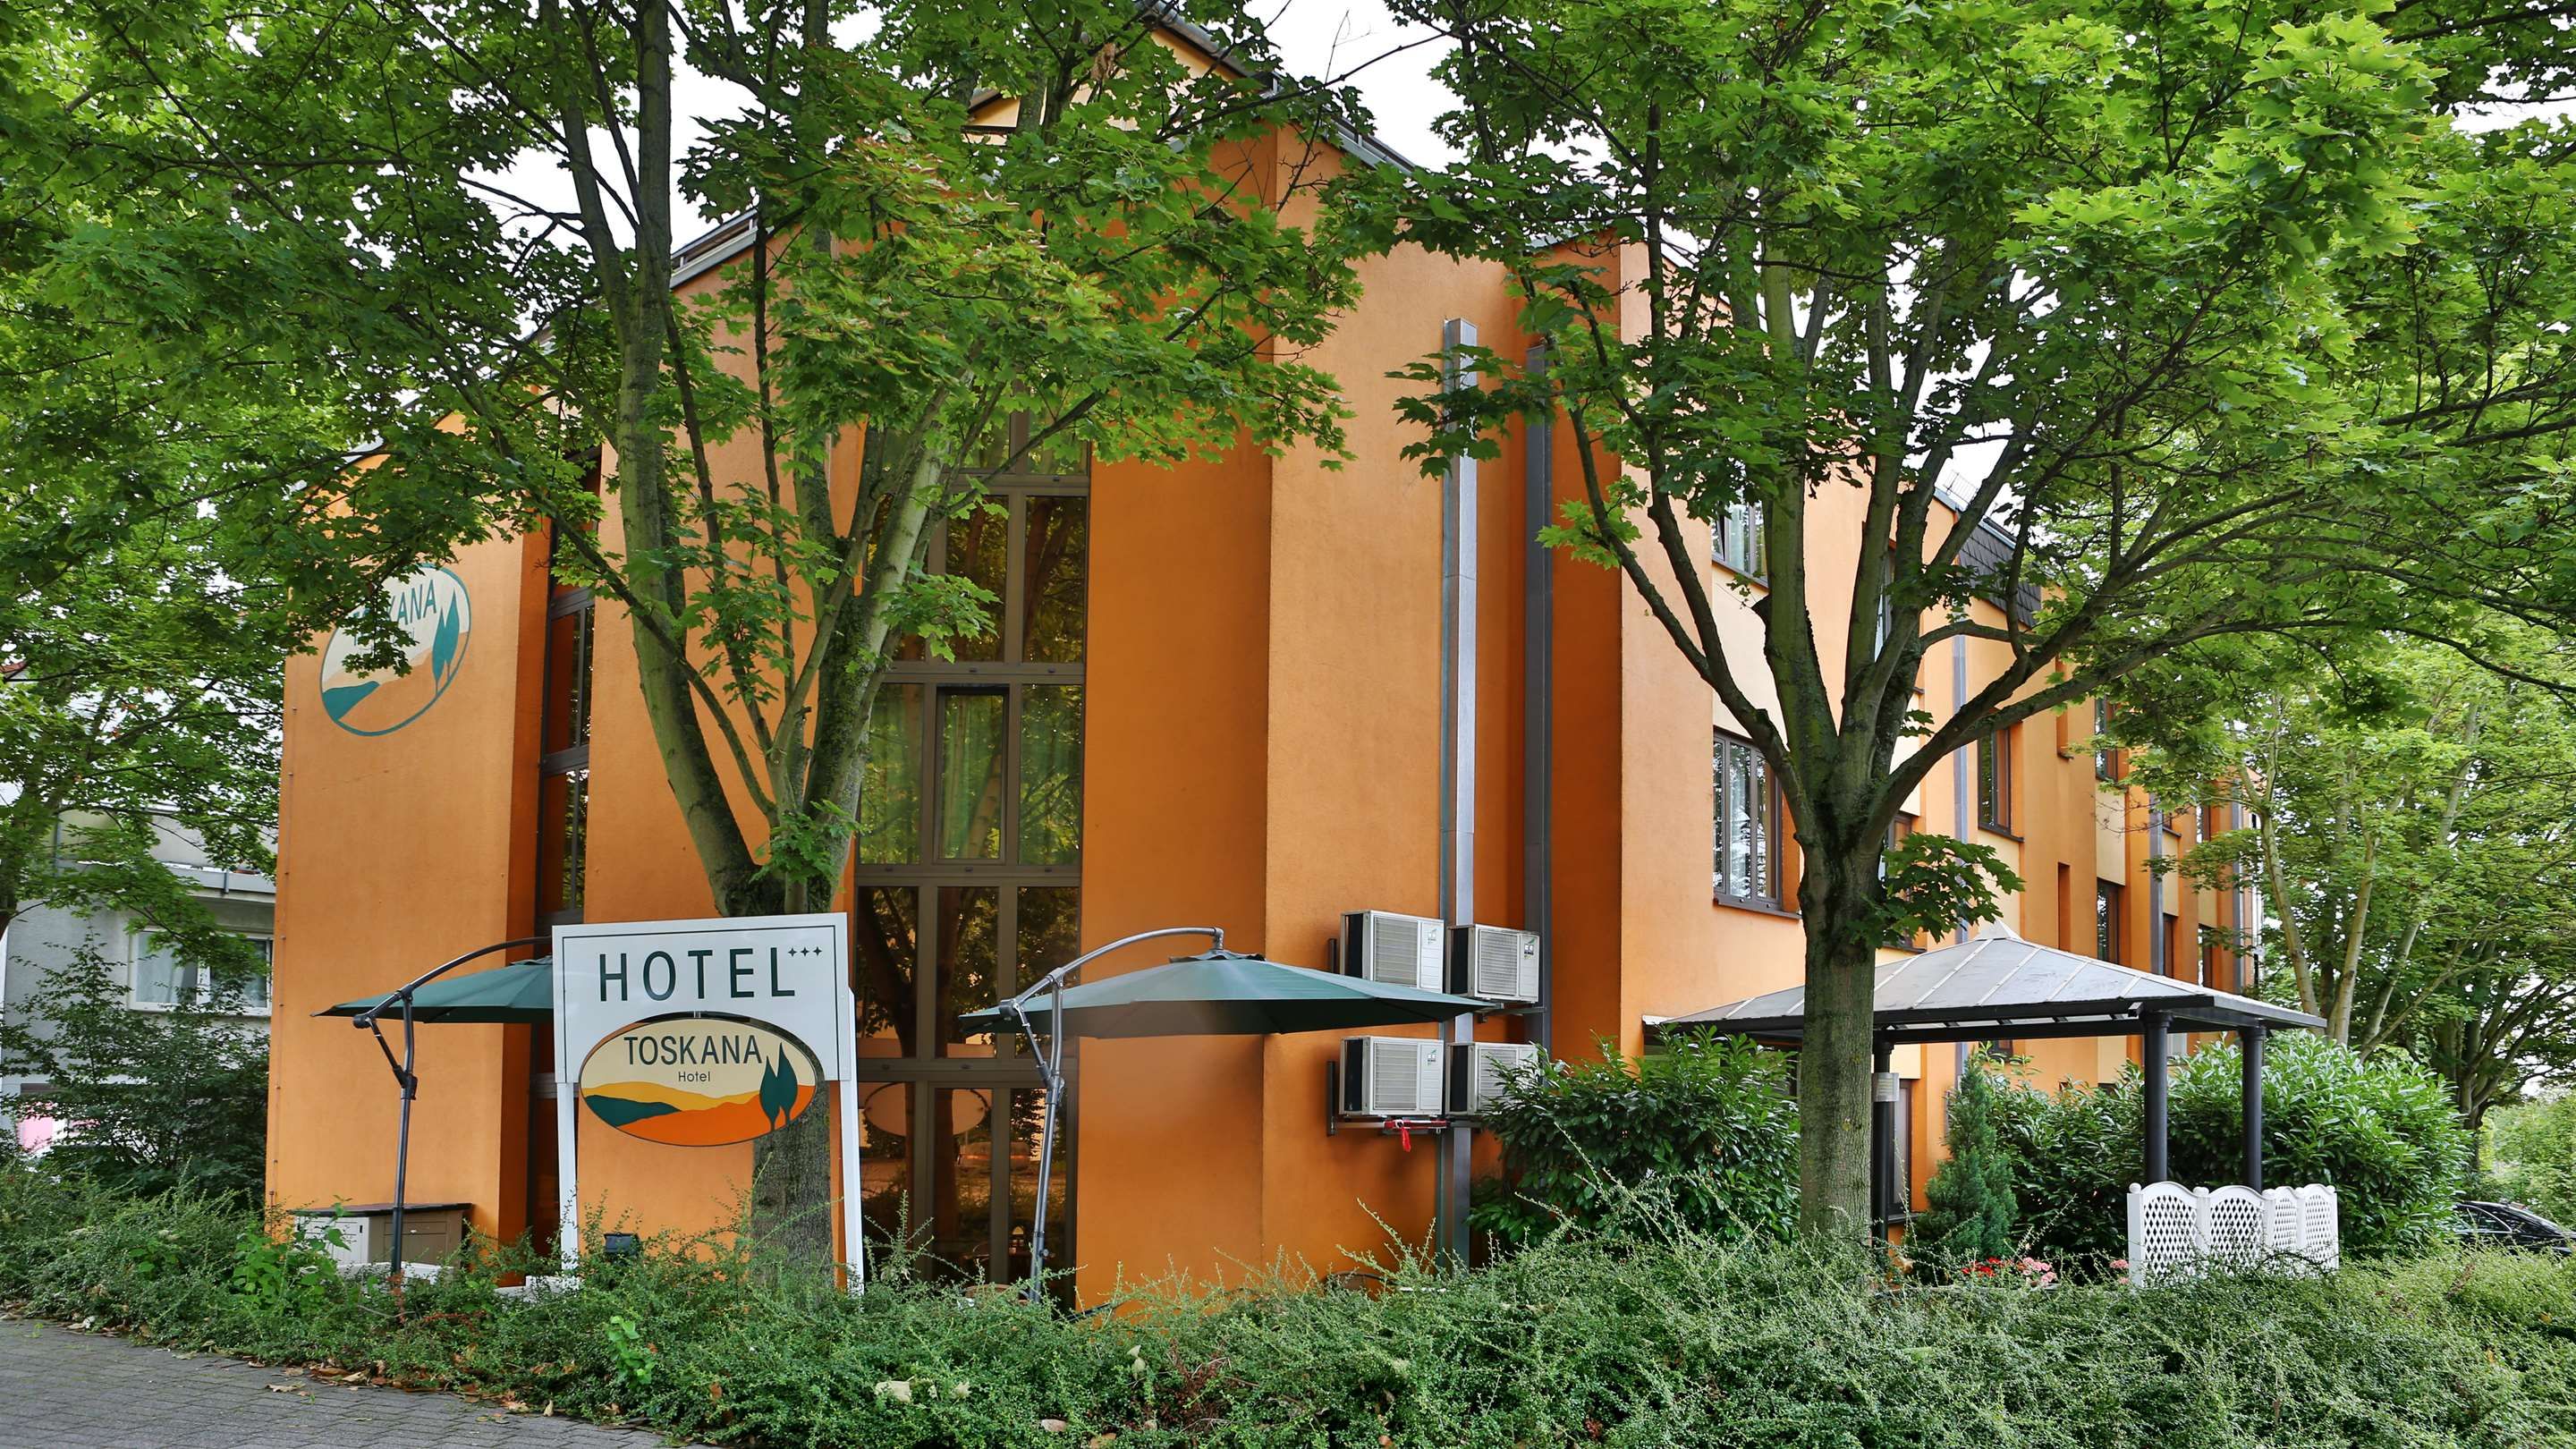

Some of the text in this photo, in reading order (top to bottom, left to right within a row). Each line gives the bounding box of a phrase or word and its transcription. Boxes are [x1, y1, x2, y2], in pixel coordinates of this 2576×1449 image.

[599, 946, 795, 1002] HOTEL
[623, 1034, 763, 1065] TOSKANA
[677, 1071, 711, 1082] Hotel
